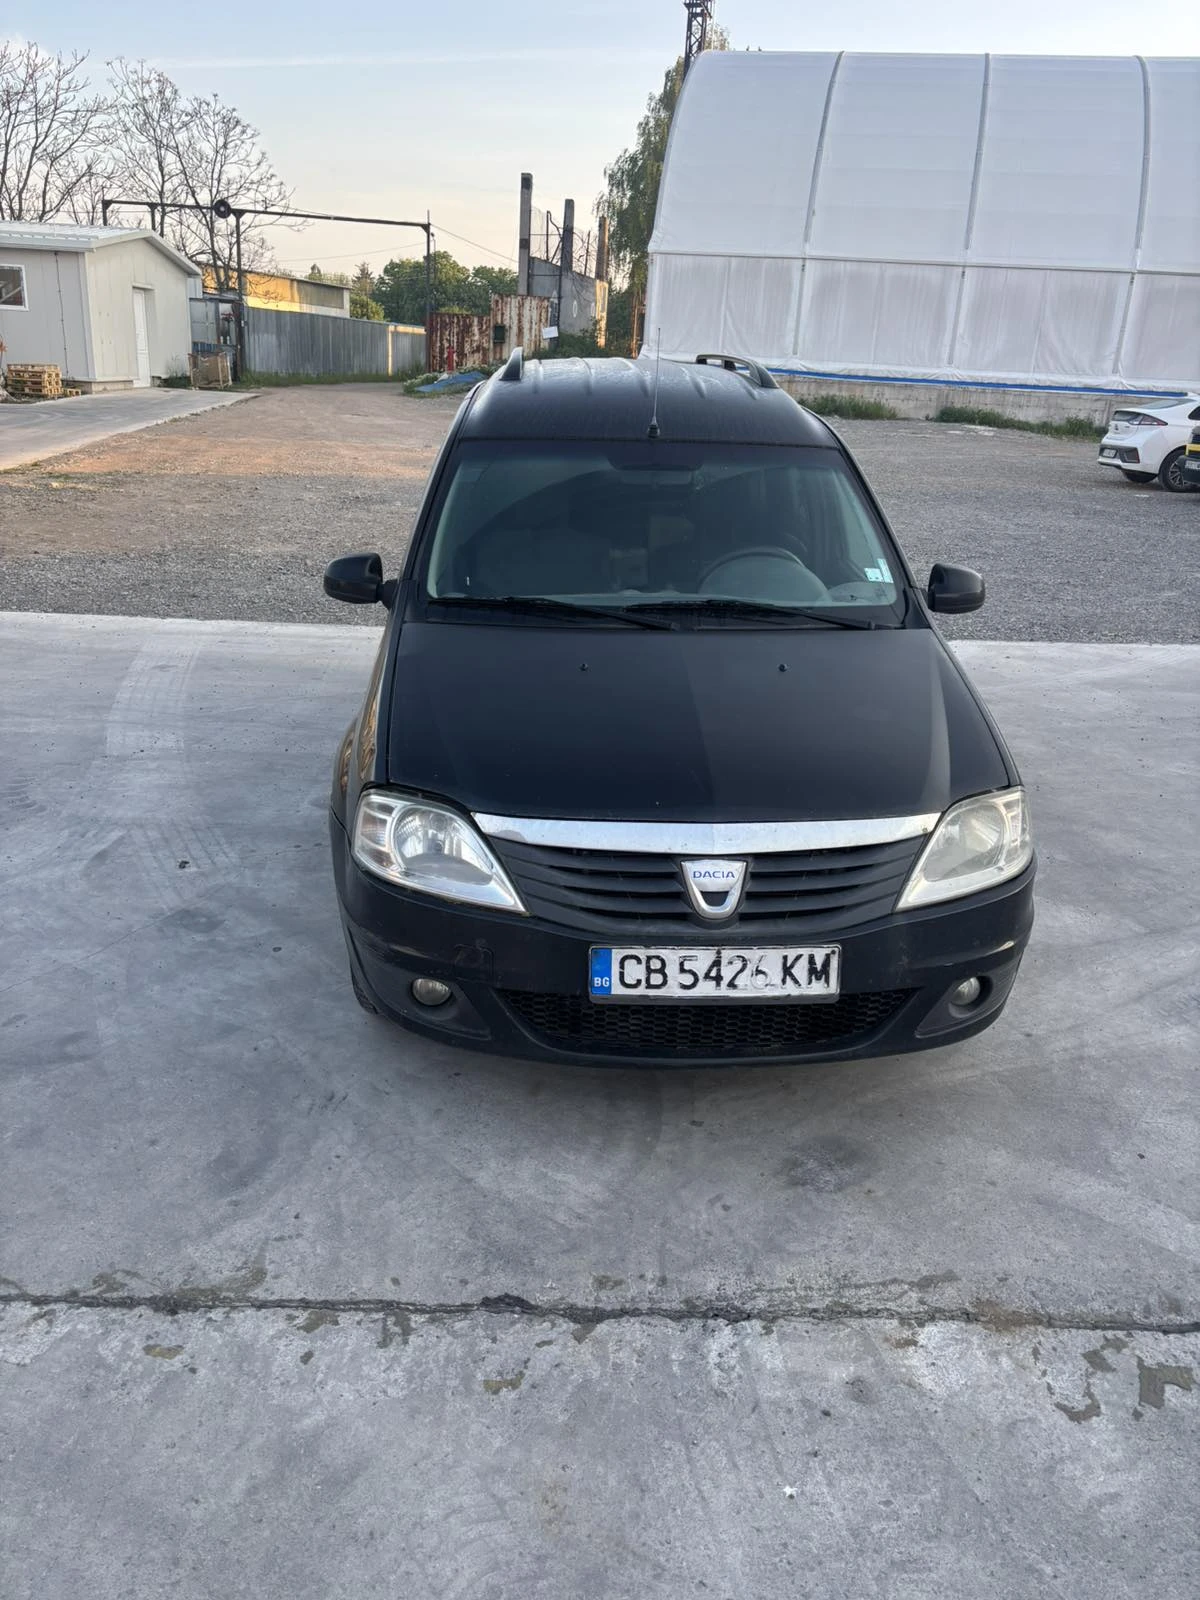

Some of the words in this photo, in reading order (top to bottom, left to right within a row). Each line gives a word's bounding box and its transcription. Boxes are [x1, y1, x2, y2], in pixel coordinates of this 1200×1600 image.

[693, 871, 735, 879] DACIA
[618, 954, 669, 990] CB
[780, 953, 832, 989] KM
[593, 977, 610, 987] BG
